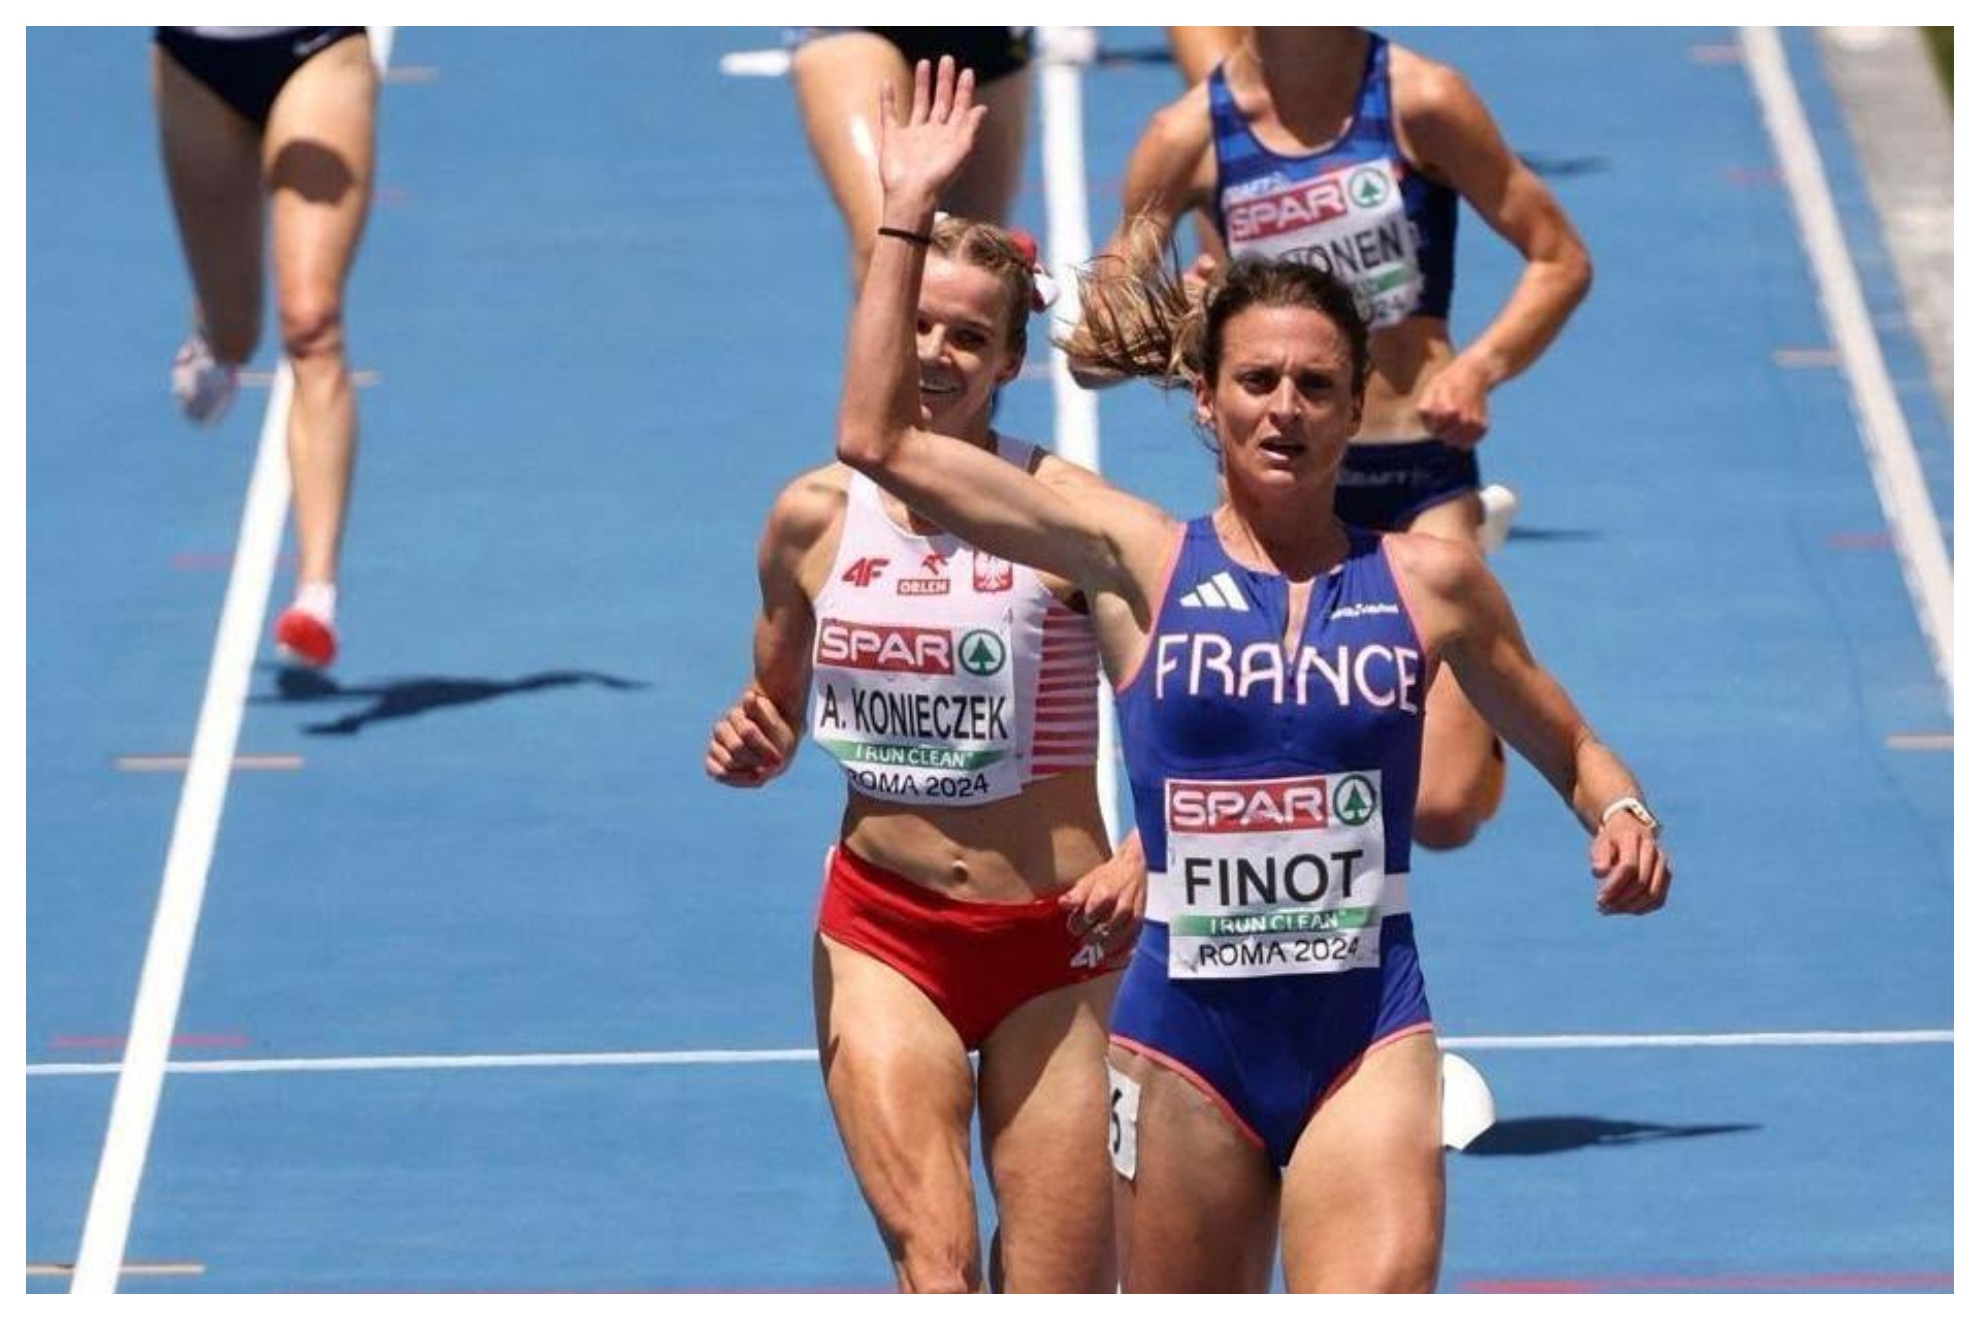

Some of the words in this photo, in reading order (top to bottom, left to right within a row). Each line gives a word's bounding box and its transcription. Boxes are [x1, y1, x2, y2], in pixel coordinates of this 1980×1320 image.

[1231, 181, 1344, 238] SPAR
[1297, 220, 1405, 276] ONEN
[842, 558, 890, 587] 4F
[899, 582, 948, 594] ORLEN
[820, 625, 950, 670] SPAR
[1156, 633, 1418, 714] FRANCE
[820, 683, 847, 729] A.
[852, 687, 1008, 740] KONIECZEK
[855, 745, 862, 758] I
[865, 746, 904, 763] RUN
[909, 747, 966, 768] CLEAN
[925, 772, 989, 799] 2024
[1172, 783, 1322, 827] SPAR
[1185, 849, 1365, 908] FINOT
[1210, 918, 1216, 934] I
[1220, 916, 1267, 934] RUN
[1272, 911, 1339, 931] CLEAN
[1199, 941, 1286, 968] ROMA
[1295, 935, 1360, 963] 2024
